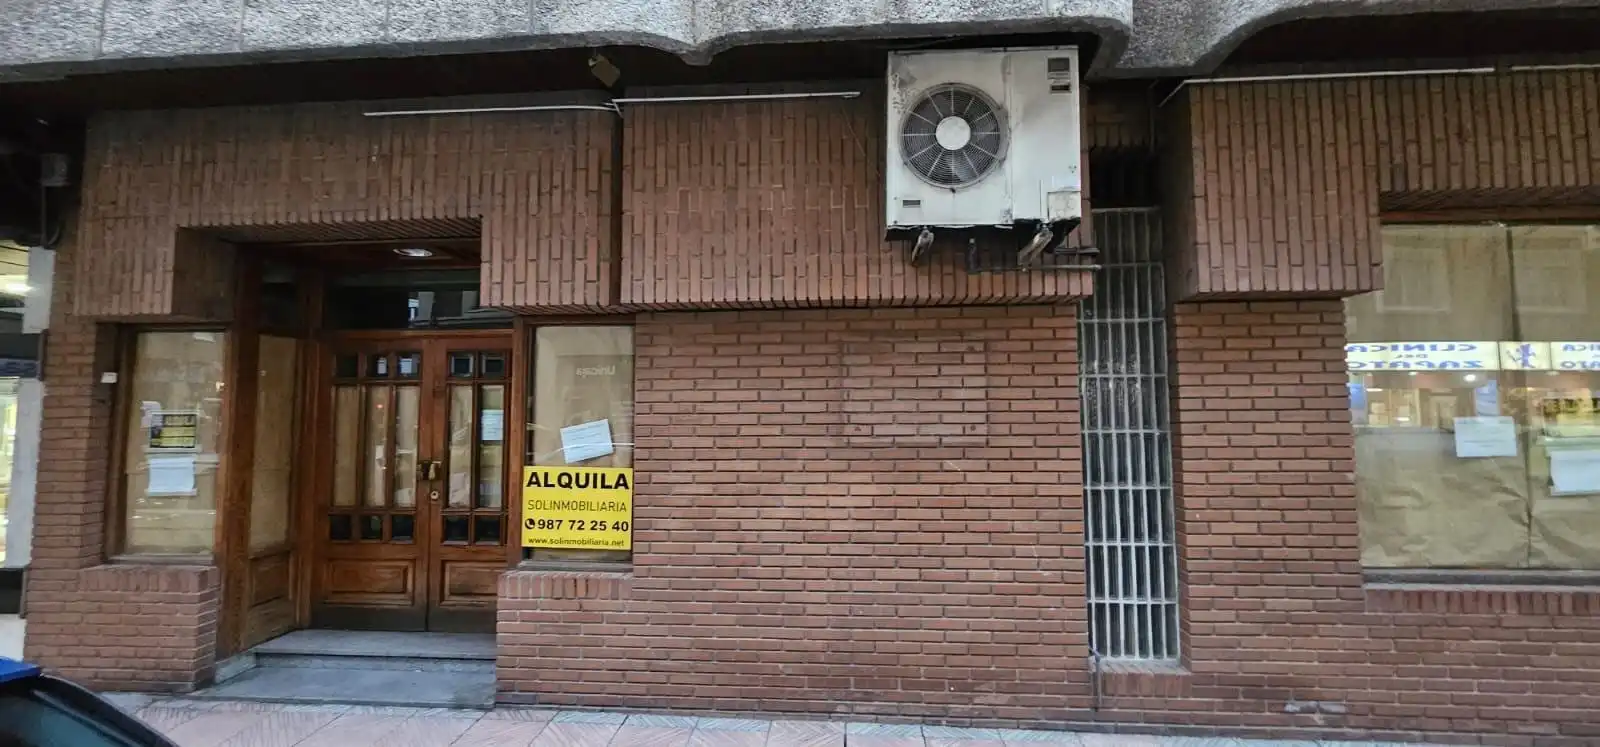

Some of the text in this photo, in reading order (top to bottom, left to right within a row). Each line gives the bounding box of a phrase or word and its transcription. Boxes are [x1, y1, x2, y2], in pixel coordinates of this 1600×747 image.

[526, 471, 630, 490] ALQUILA
[527, 499, 627, 513] SOLINMOBILIARIA
[537, 519, 629, 532] 987 72 25 40
[528, 537, 625, 547] www.solinmobiliaria.net
